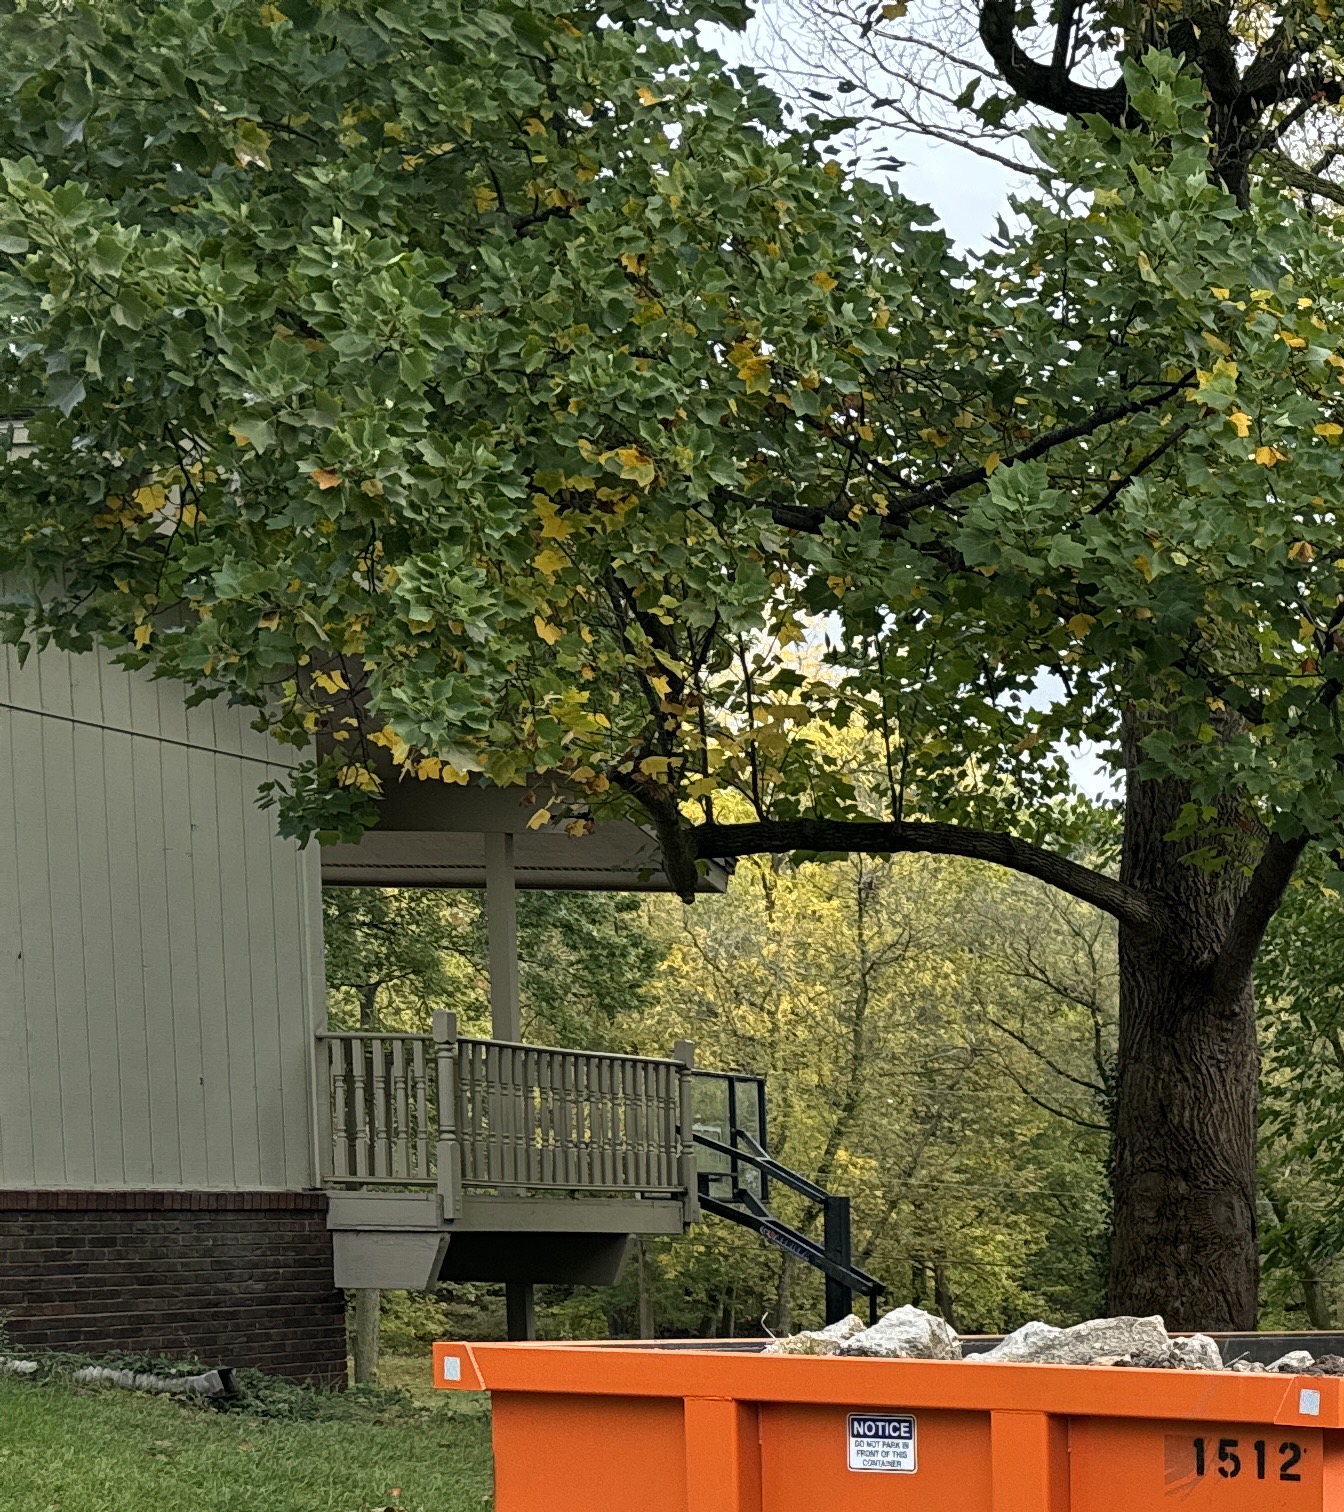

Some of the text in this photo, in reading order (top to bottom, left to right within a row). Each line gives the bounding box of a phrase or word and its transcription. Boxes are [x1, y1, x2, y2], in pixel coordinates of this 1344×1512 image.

[853, 1421, 911, 1437] NOTICE
[882, 1441, 900, 1450] PARK
[856, 1449, 879, 1458] FRONT
[881, 1450, 890, 1459] OF
[1193, 1438, 1301, 1481] 1512
